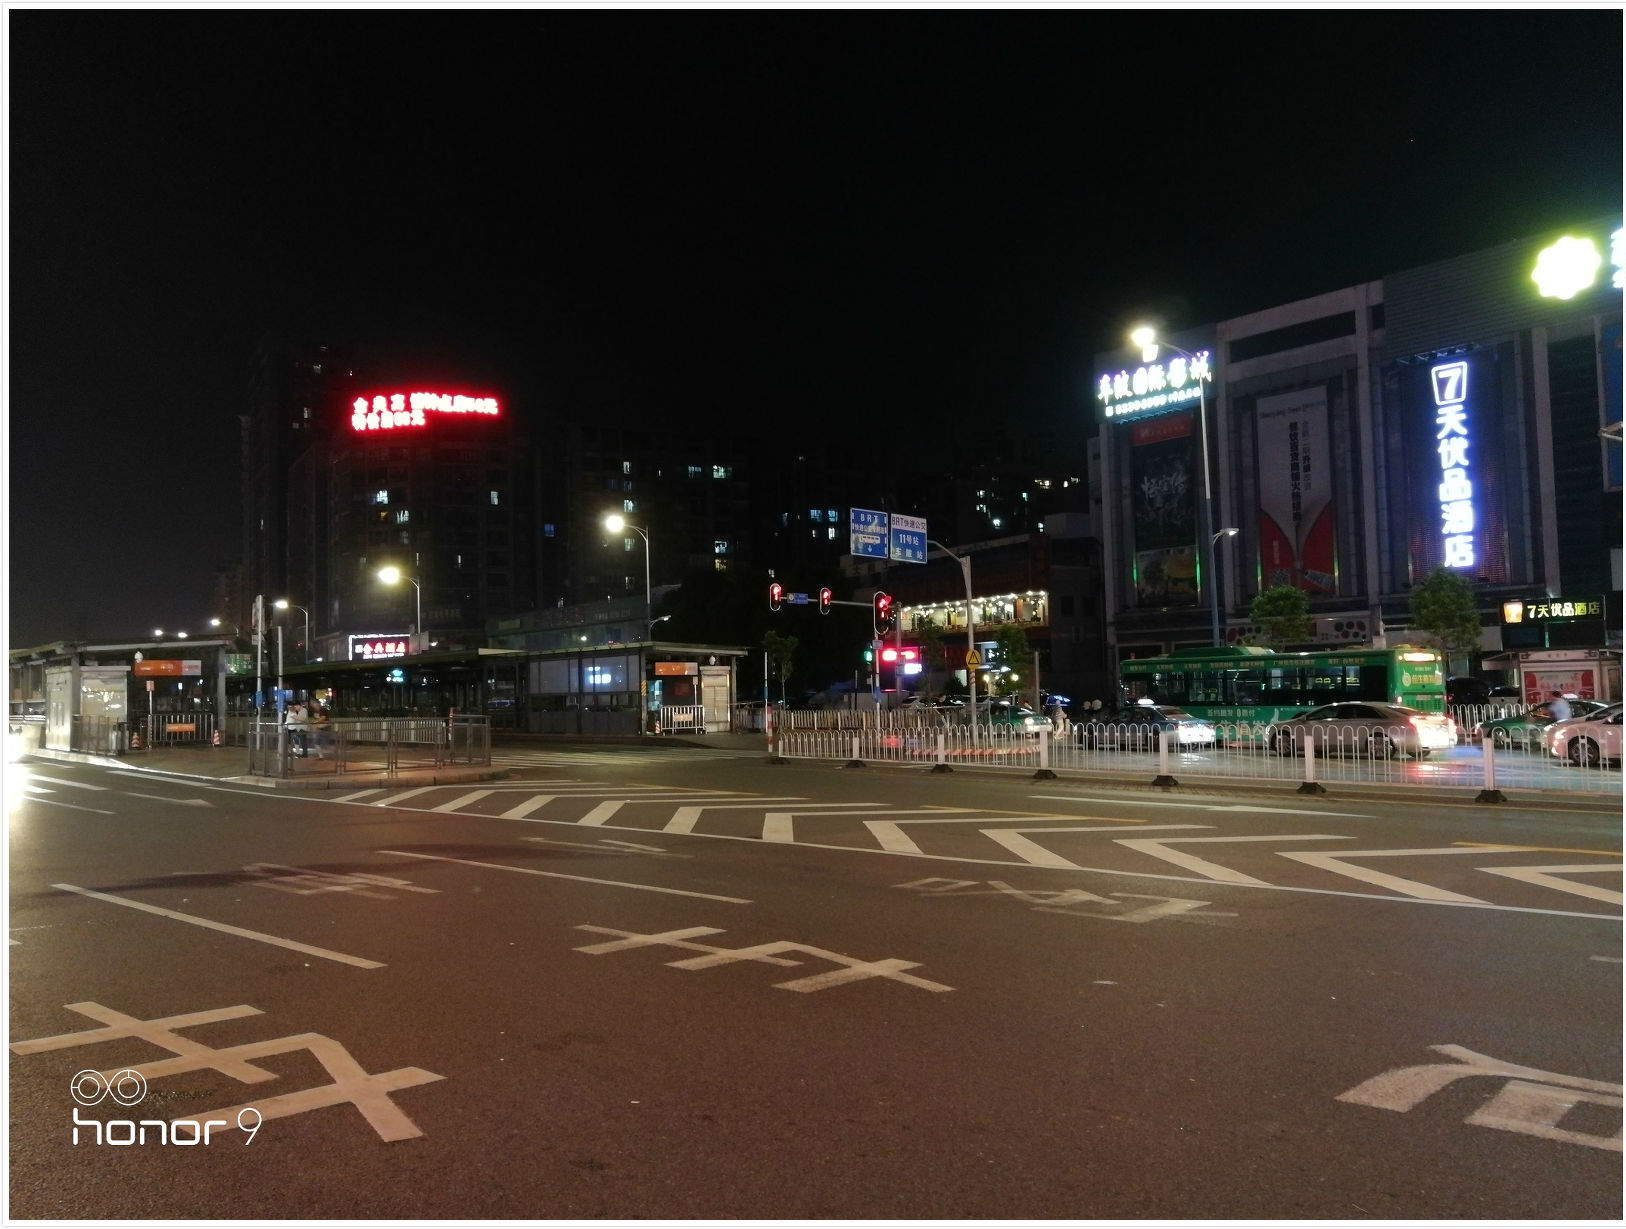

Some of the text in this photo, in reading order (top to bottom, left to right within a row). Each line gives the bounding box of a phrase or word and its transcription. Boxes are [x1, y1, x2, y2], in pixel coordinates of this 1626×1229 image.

[860, 513, 879, 523] BRT
[891, 516, 927, 530] BRT快速公交
[899, 533, 919, 546] 11号站
[1527, 602, 1600, 619] 7天优品酒店
